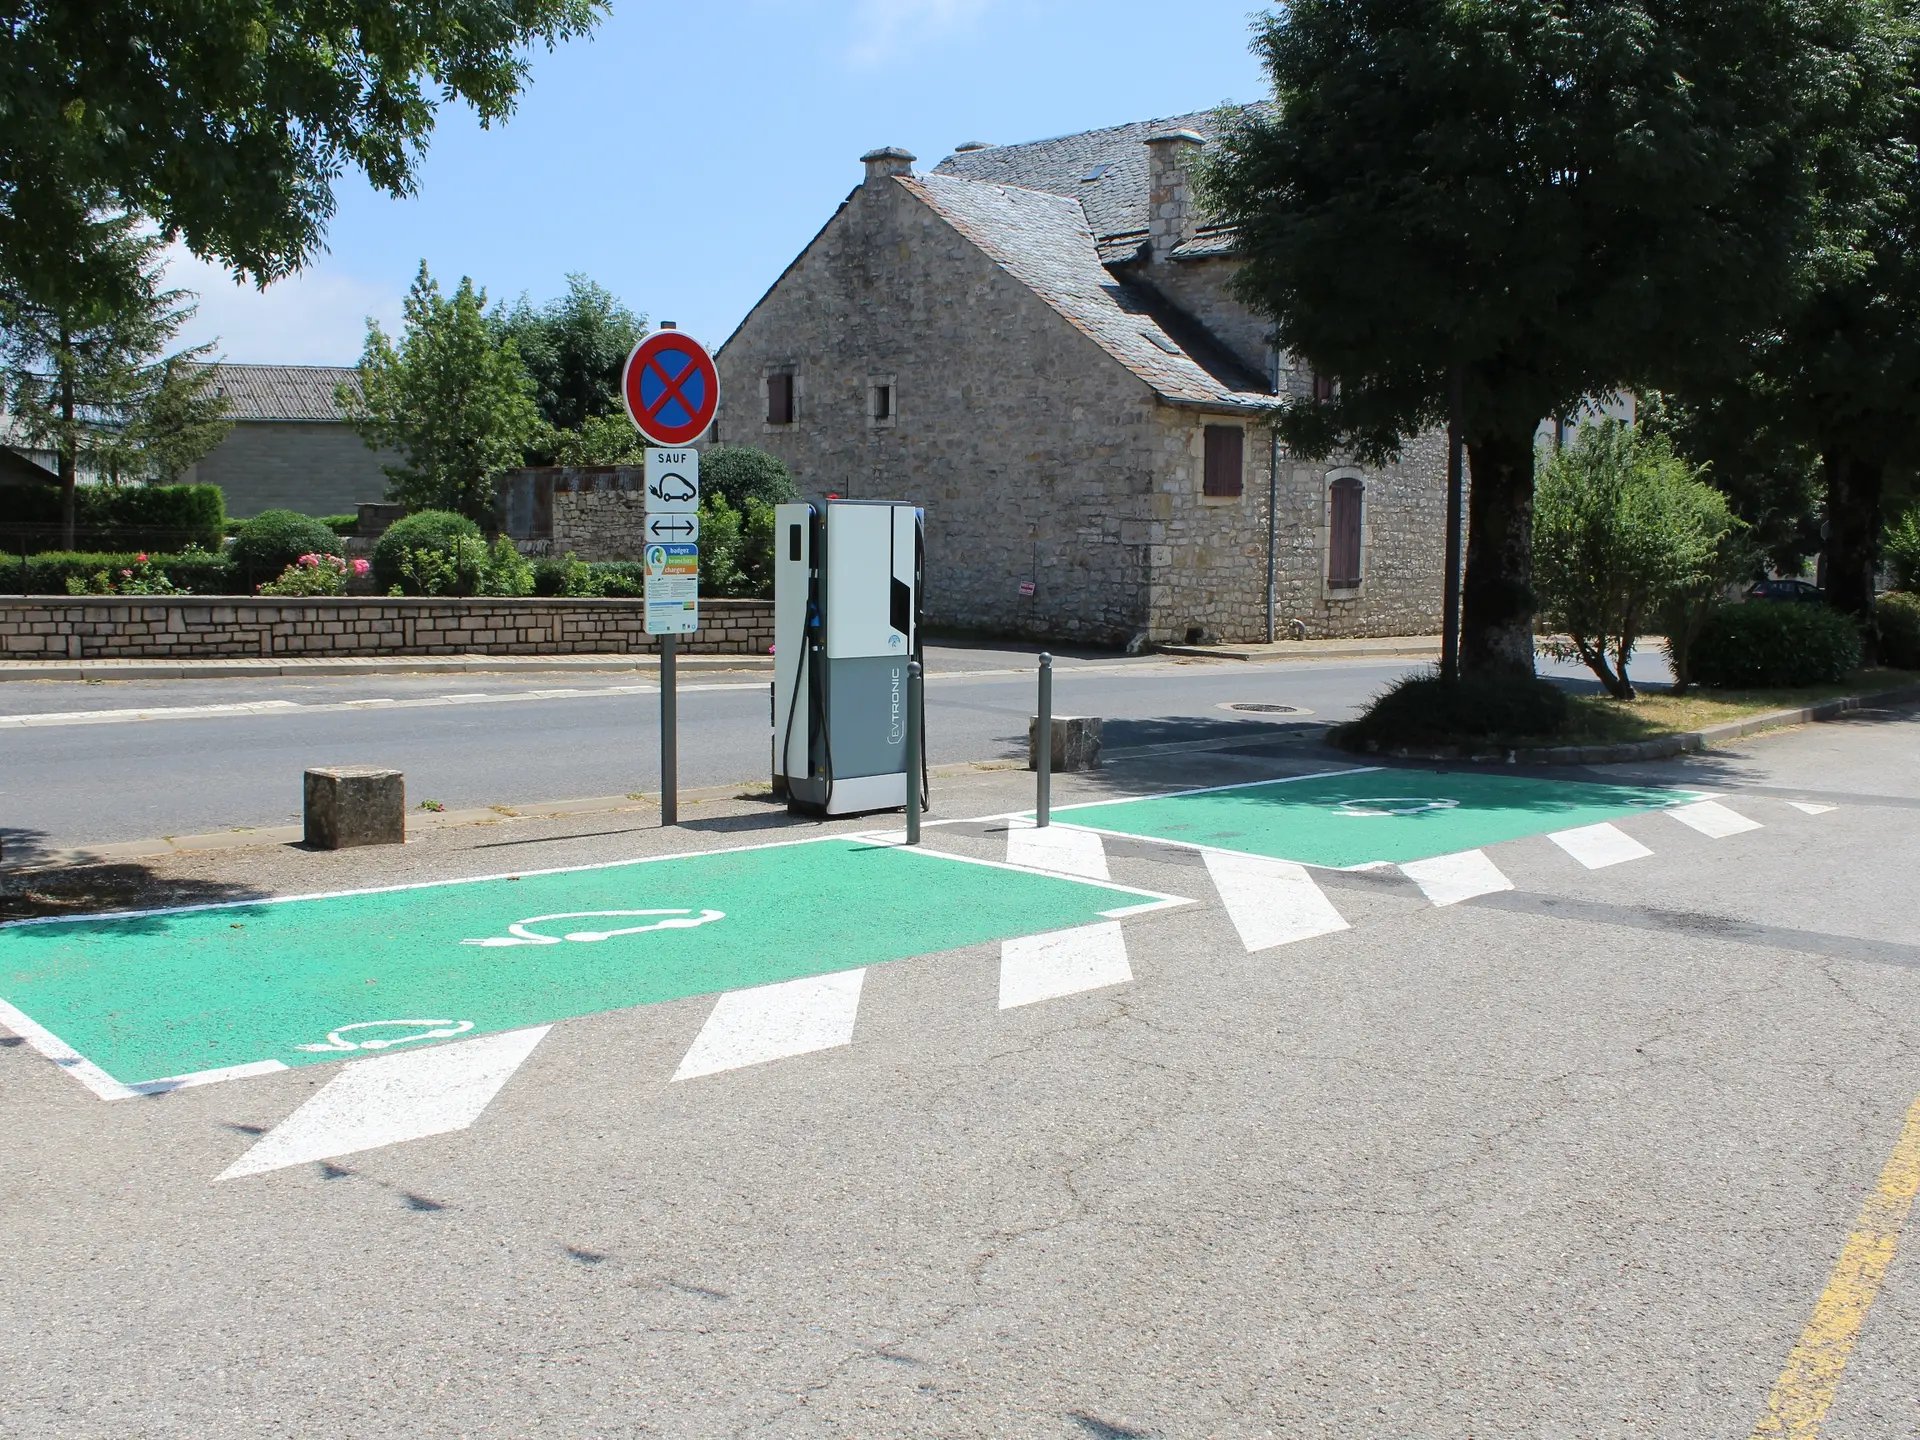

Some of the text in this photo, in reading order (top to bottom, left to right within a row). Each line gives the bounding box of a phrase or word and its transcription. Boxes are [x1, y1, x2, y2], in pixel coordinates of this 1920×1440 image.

[658, 453, 687, 463] SAUF
[670, 547, 689, 555] badgez
[665, 566, 686, 574] chargez
[891, 668, 900, 738] EVTRONIC
